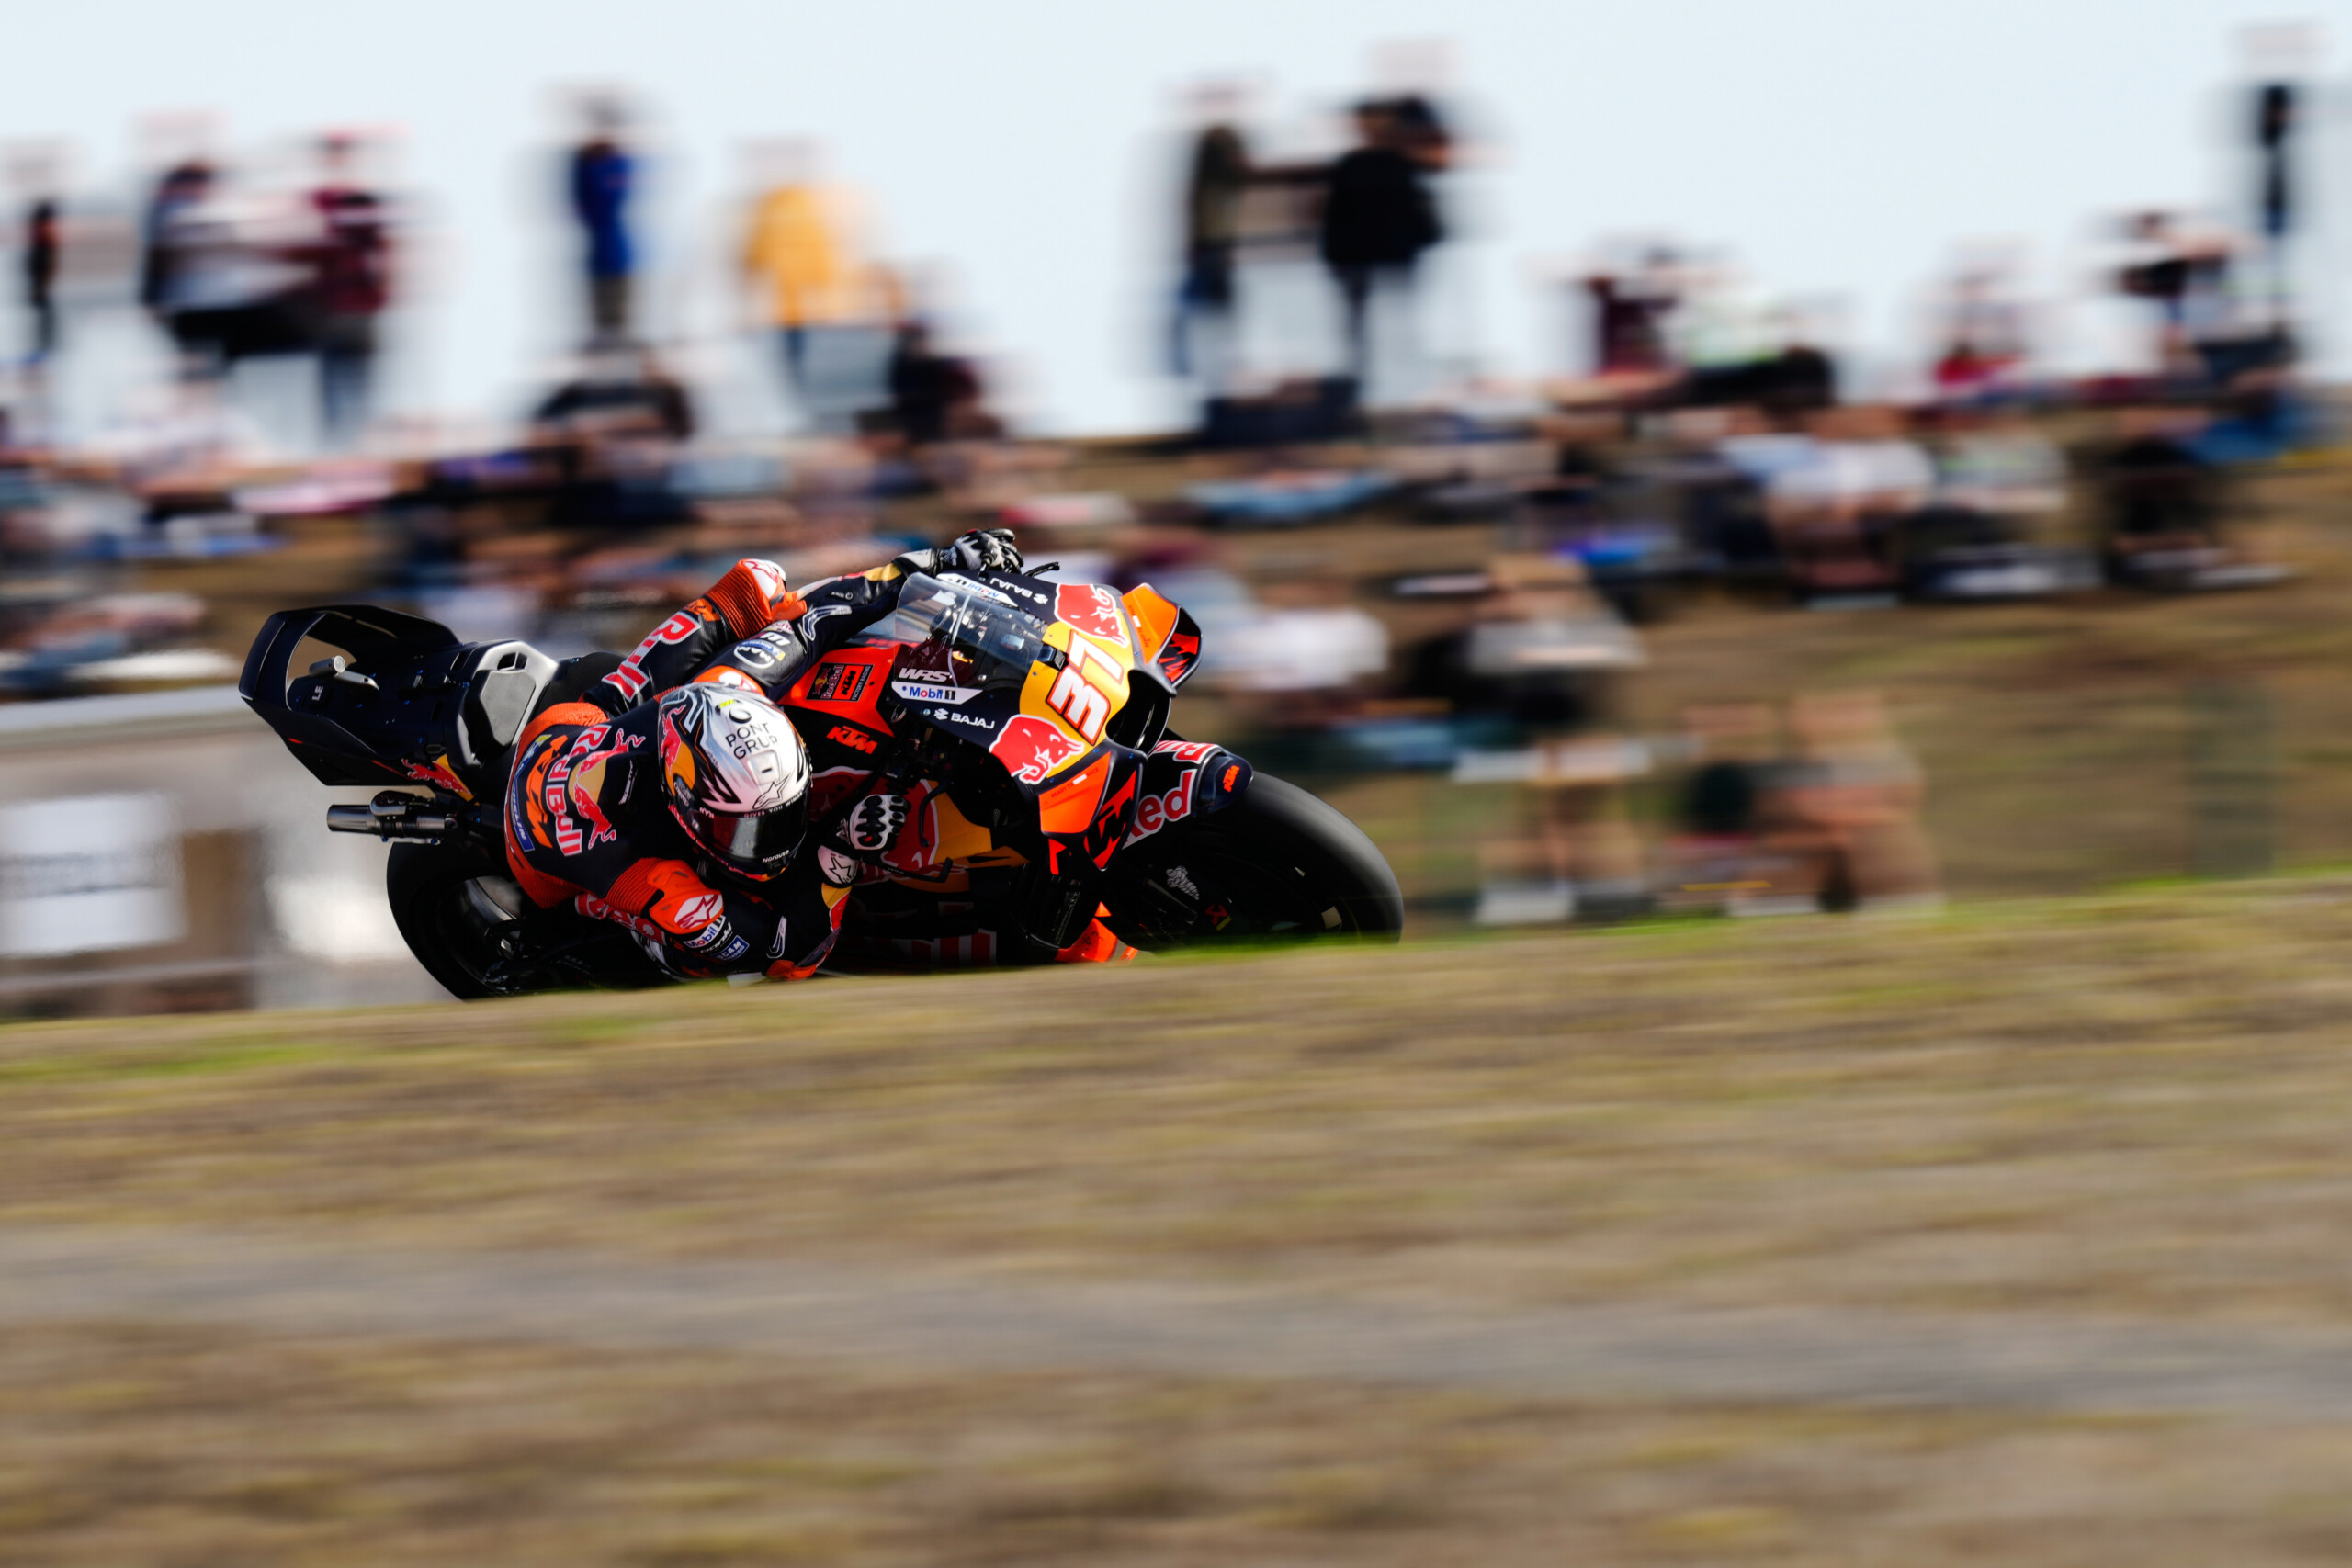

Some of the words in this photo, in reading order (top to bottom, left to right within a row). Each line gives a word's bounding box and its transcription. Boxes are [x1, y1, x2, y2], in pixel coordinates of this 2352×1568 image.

[968, 582, 1000, 598] Mobil
[989, 577, 1034, 598] BAJAJ
[841, 670, 856, 695] KTM
[899, 668, 951, 682] WRS
[909, 686, 944, 699] Mobil
[1046, 630, 1124, 746] 31
[951, 712, 995, 729] BAJAJ
[725, 722, 770, 748] PONT
[826, 726, 878, 754] KTM
[733, 735, 778, 761] GRUP
[1223, 765, 1240, 793] KTM
[762, 849, 789, 863] Norauto
[687, 926, 718, 947] Mobil
